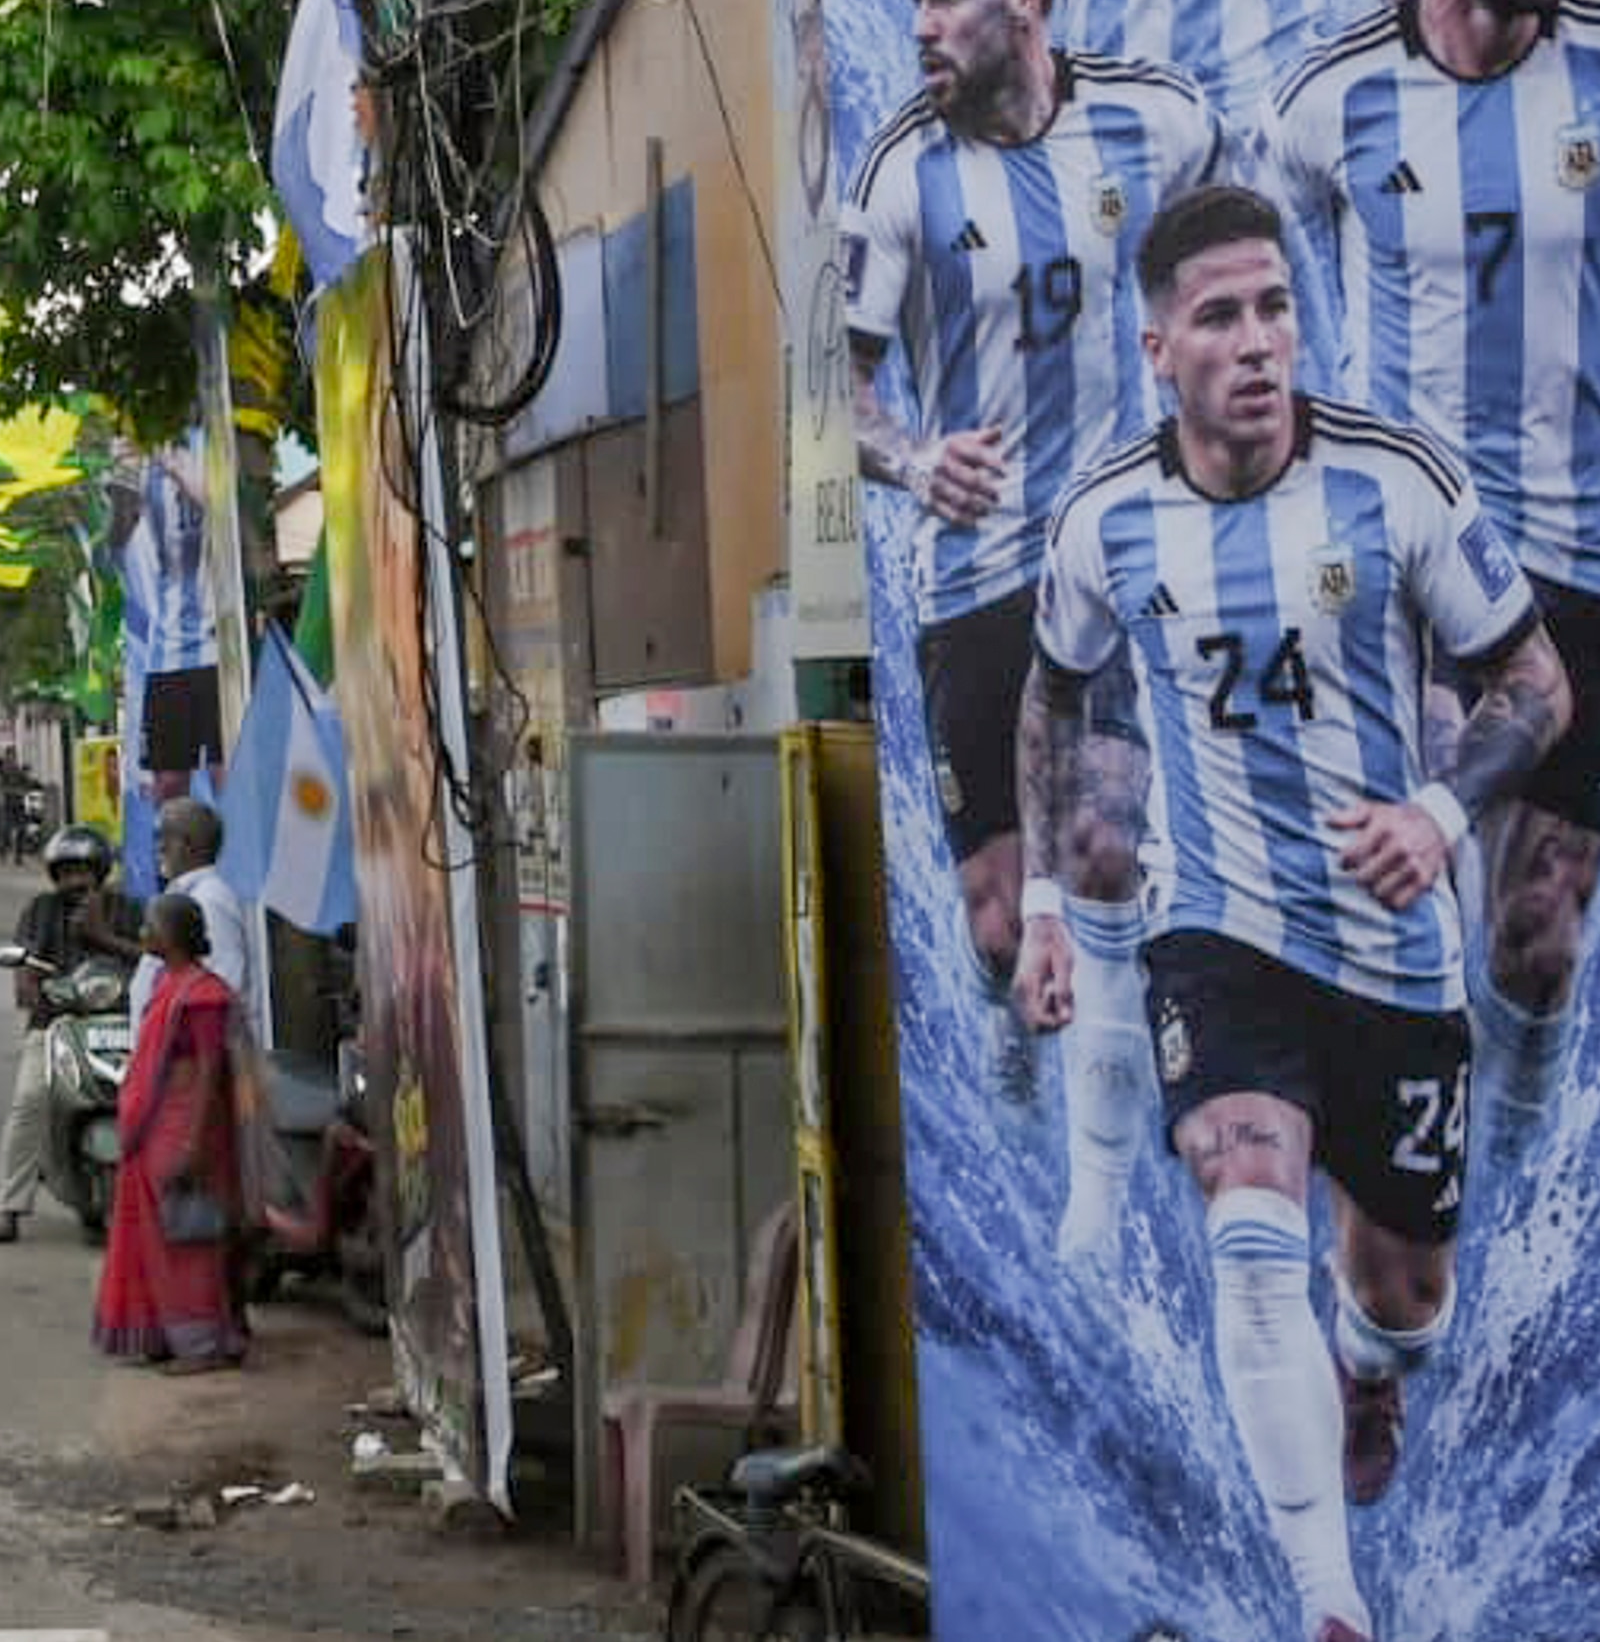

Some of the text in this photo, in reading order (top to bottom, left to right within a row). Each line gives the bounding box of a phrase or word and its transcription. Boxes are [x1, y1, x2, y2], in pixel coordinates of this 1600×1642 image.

[1010, 256, 1083, 351] 19
[1464, 211, 1518, 304] 7
[1196, 626, 1315, 732] 24
[1392, 1062, 1469, 1172] 24
